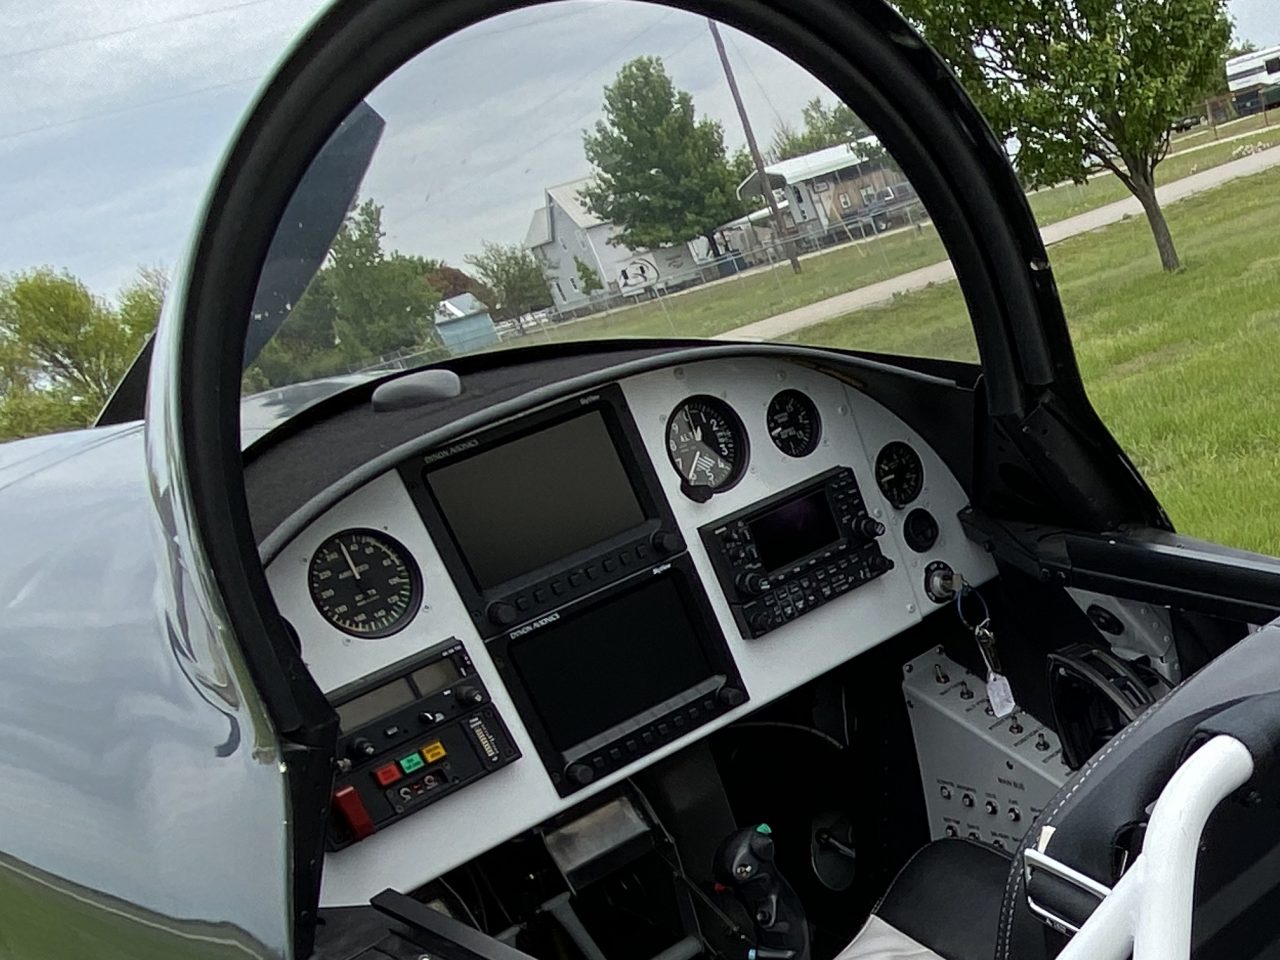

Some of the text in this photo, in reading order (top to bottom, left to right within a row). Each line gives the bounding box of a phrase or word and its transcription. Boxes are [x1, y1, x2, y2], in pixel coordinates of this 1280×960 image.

[672, 423, 679, 434] 9
[710, 419, 719, 431] 2
[680, 431, 694, 442] ALT
[670, 440, 677, 451] 8
[719, 443, 729, 455] 3
[675, 458, 683, 469] 7
[717, 457, 725, 468] 4
[705, 469, 714, 481] 5
